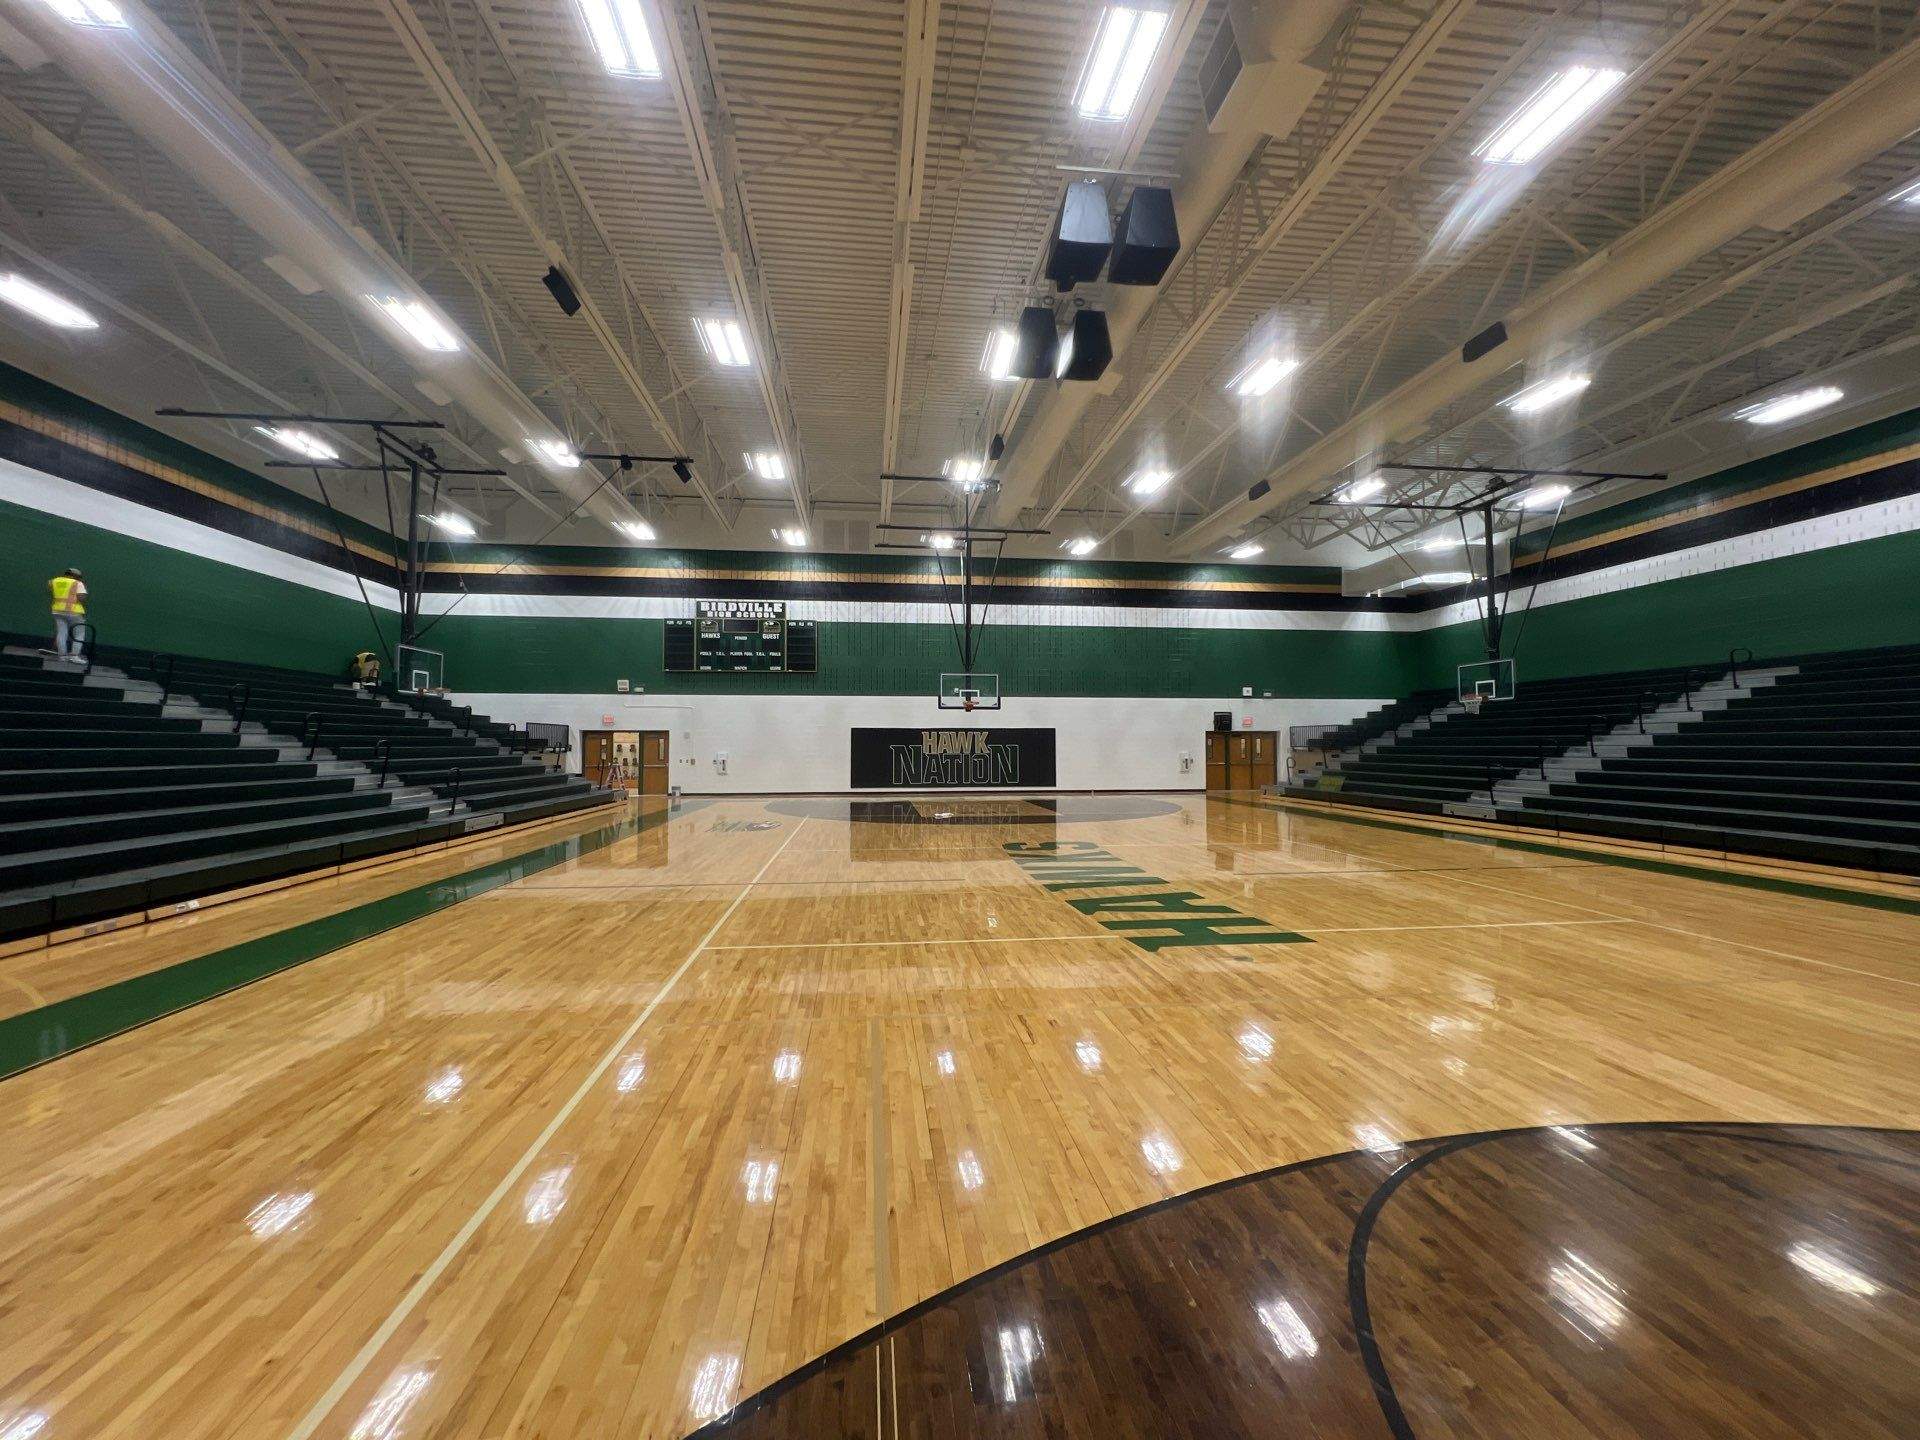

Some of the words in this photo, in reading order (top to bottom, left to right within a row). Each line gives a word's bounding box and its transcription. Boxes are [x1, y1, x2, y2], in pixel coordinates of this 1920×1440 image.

[700, 601, 783, 612] BIRDVILLE
[736, 611, 776, 619] SCHOOL
[922, 731, 991, 754] HAWK
[890, 744, 1020, 784] NATION
[1002, 840, 1317, 952] HAWKS
